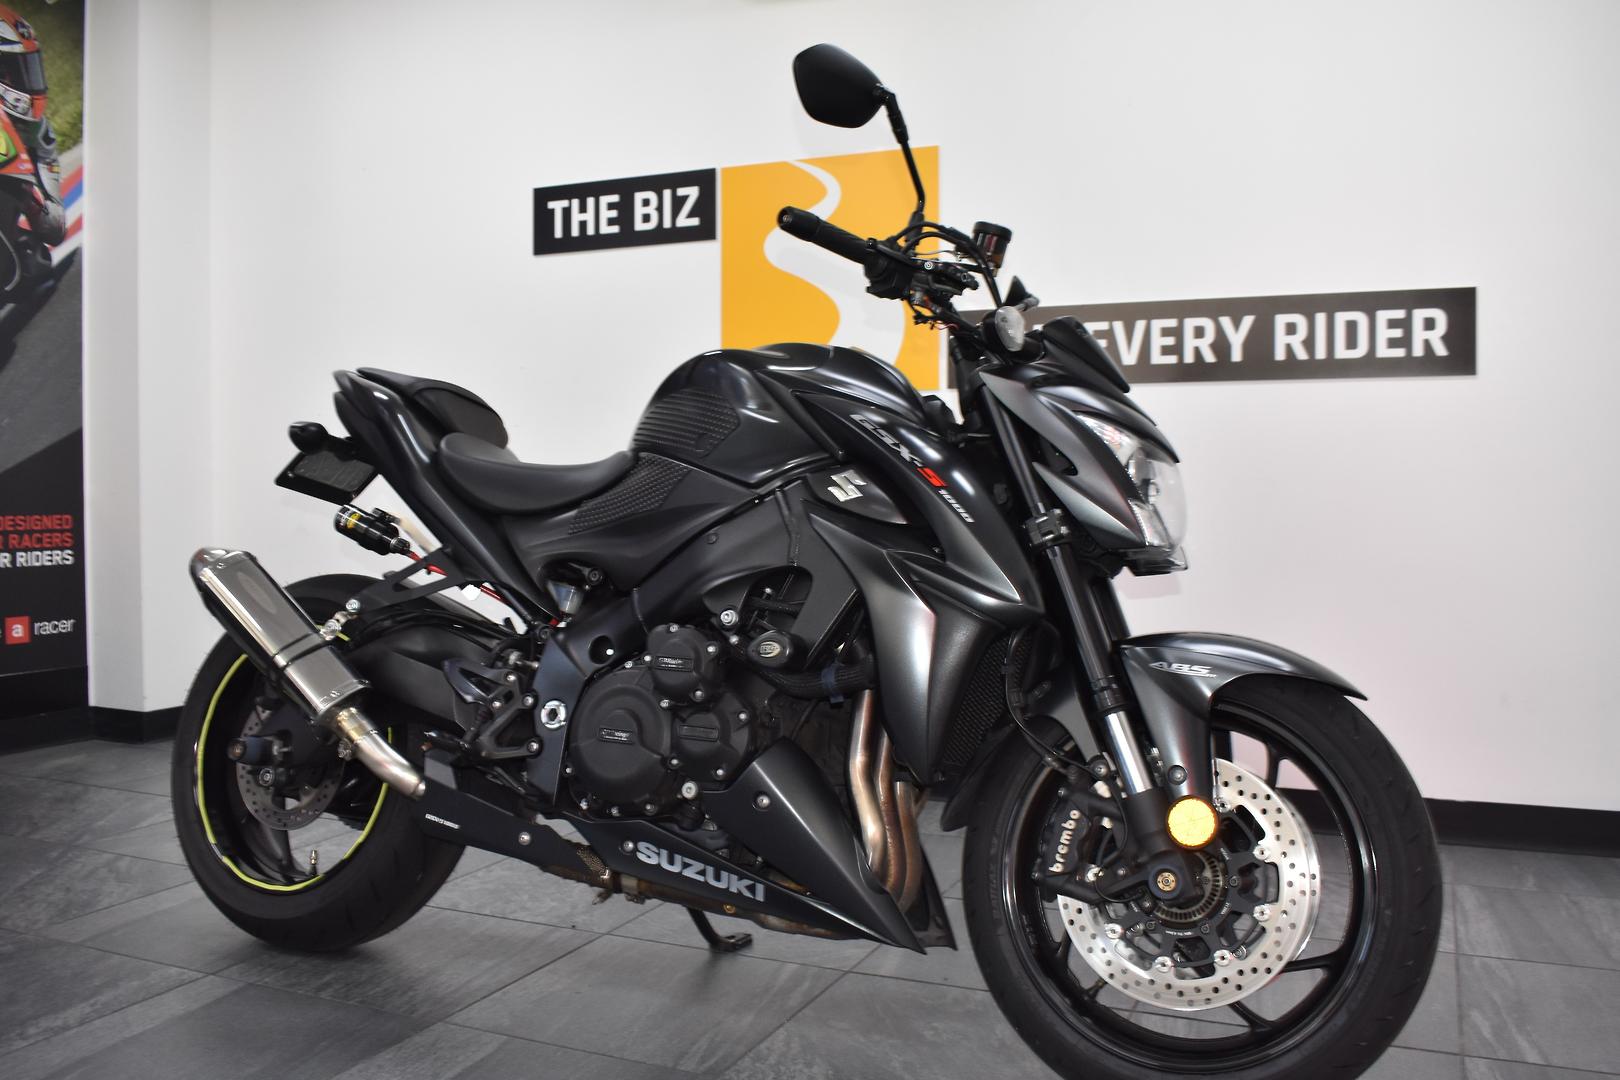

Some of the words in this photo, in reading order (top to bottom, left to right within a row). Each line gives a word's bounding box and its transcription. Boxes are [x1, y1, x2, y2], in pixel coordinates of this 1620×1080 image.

[547, 193, 621, 239] THE
[633, 185, 701, 232] BIZ
[1274, 307, 1450, 361] RIDER
[8, 533, 73, 549] RACERS
[16, 550, 74, 567] RIDERS
[34, 618, 75, 635] racer
[1048, 809, 1081, 873] brembo
[635, 841, 765, 902] SUZUKI
